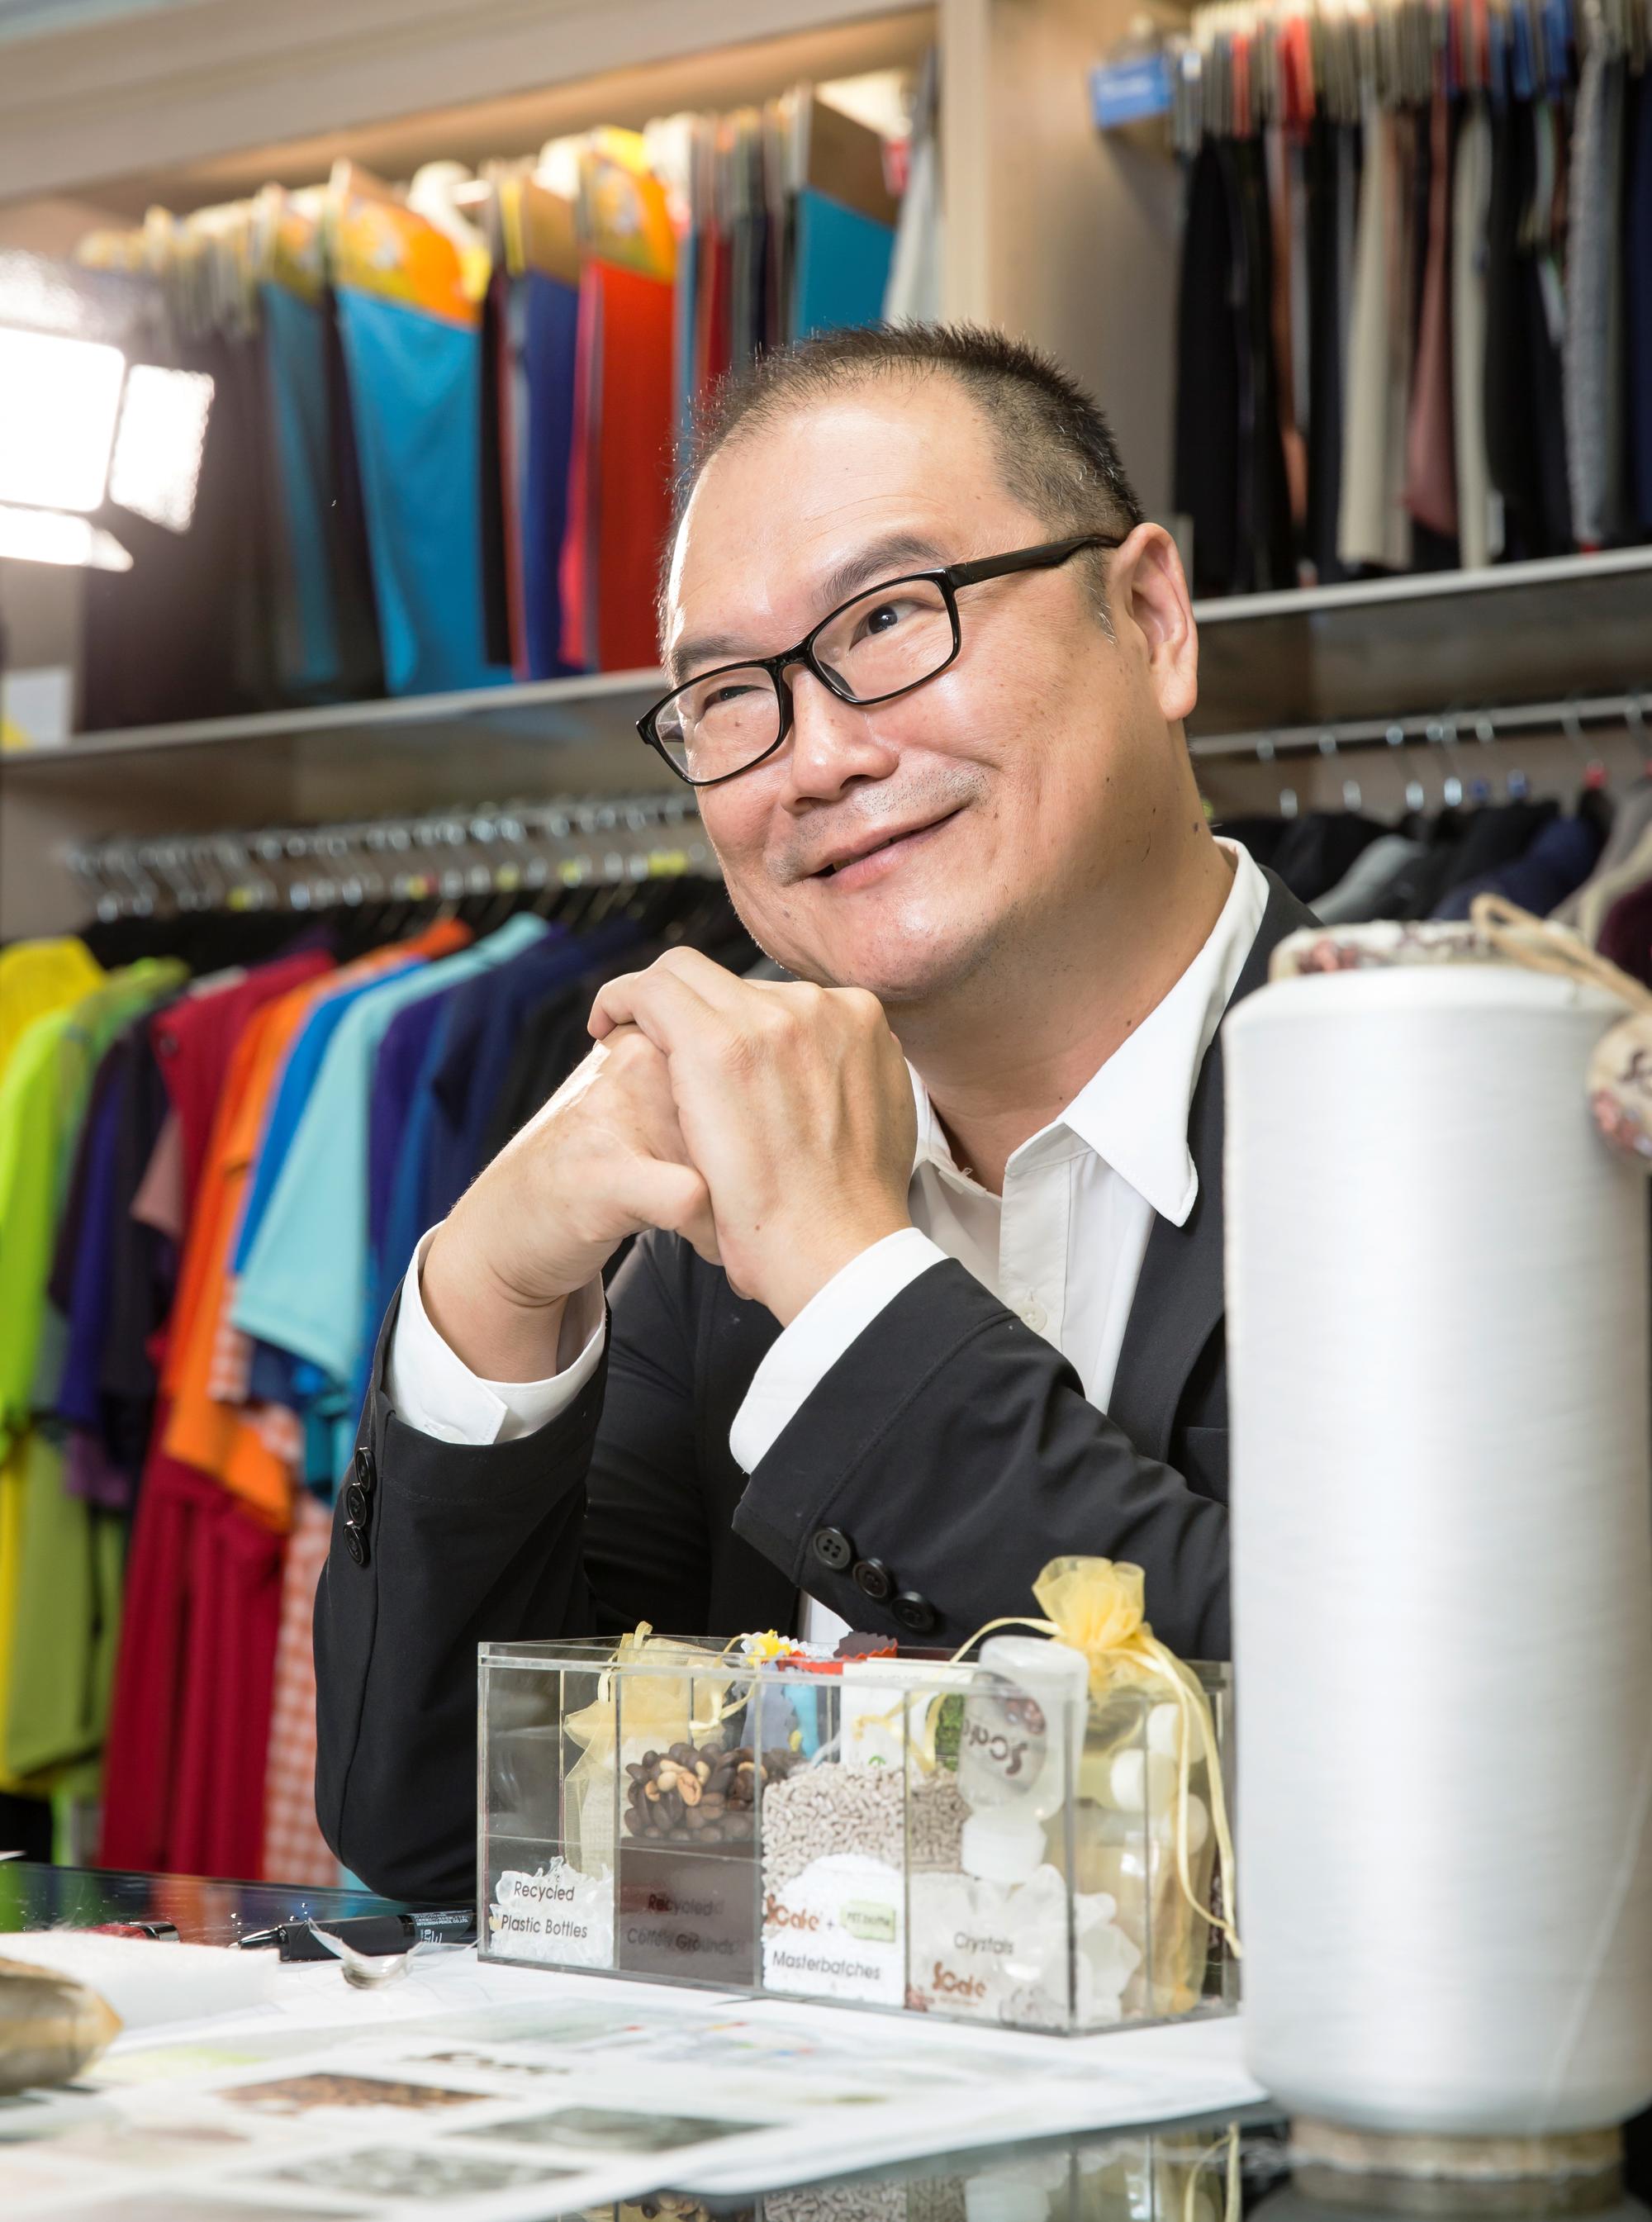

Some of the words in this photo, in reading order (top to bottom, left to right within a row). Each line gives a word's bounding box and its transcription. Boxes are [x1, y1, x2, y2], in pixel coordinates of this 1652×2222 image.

[514, 1881, 575, 1902] Recycled
[648, 1893, 715, 1916] Recycled
[501, 1915, 541, 1933] Plastic
[545, 1919, 588, 1938] Bottles
[676, 1934, 734, 1955] Grounds
[954, 1931, 1014, 1955] Crystals
[772, 1950, 881, 1980] Masterbatches
